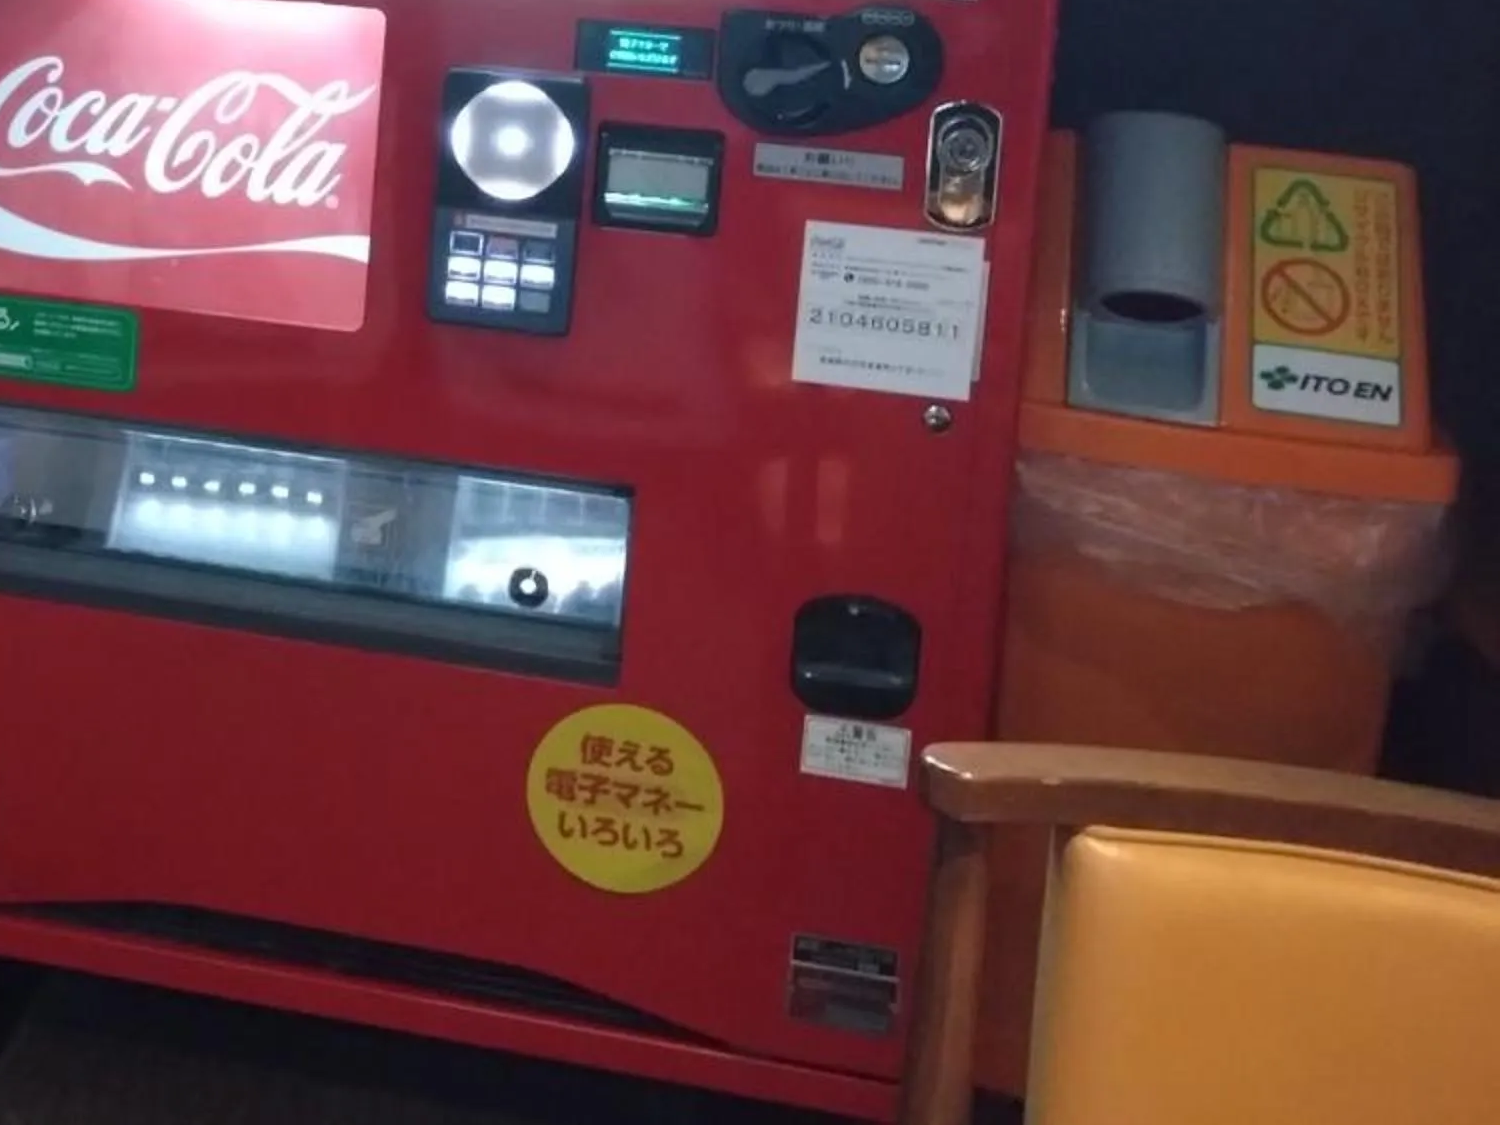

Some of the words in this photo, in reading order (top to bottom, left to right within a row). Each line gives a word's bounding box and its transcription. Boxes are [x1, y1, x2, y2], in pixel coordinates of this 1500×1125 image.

[1299, 372, 1354, 397] ITO
[1354, 378, 1394, 403] EN
[580, 731, 675, 777] 使える
[544, 767, 705, 817] 電子マネー
[557, 810, 685, 860] いろいろ
